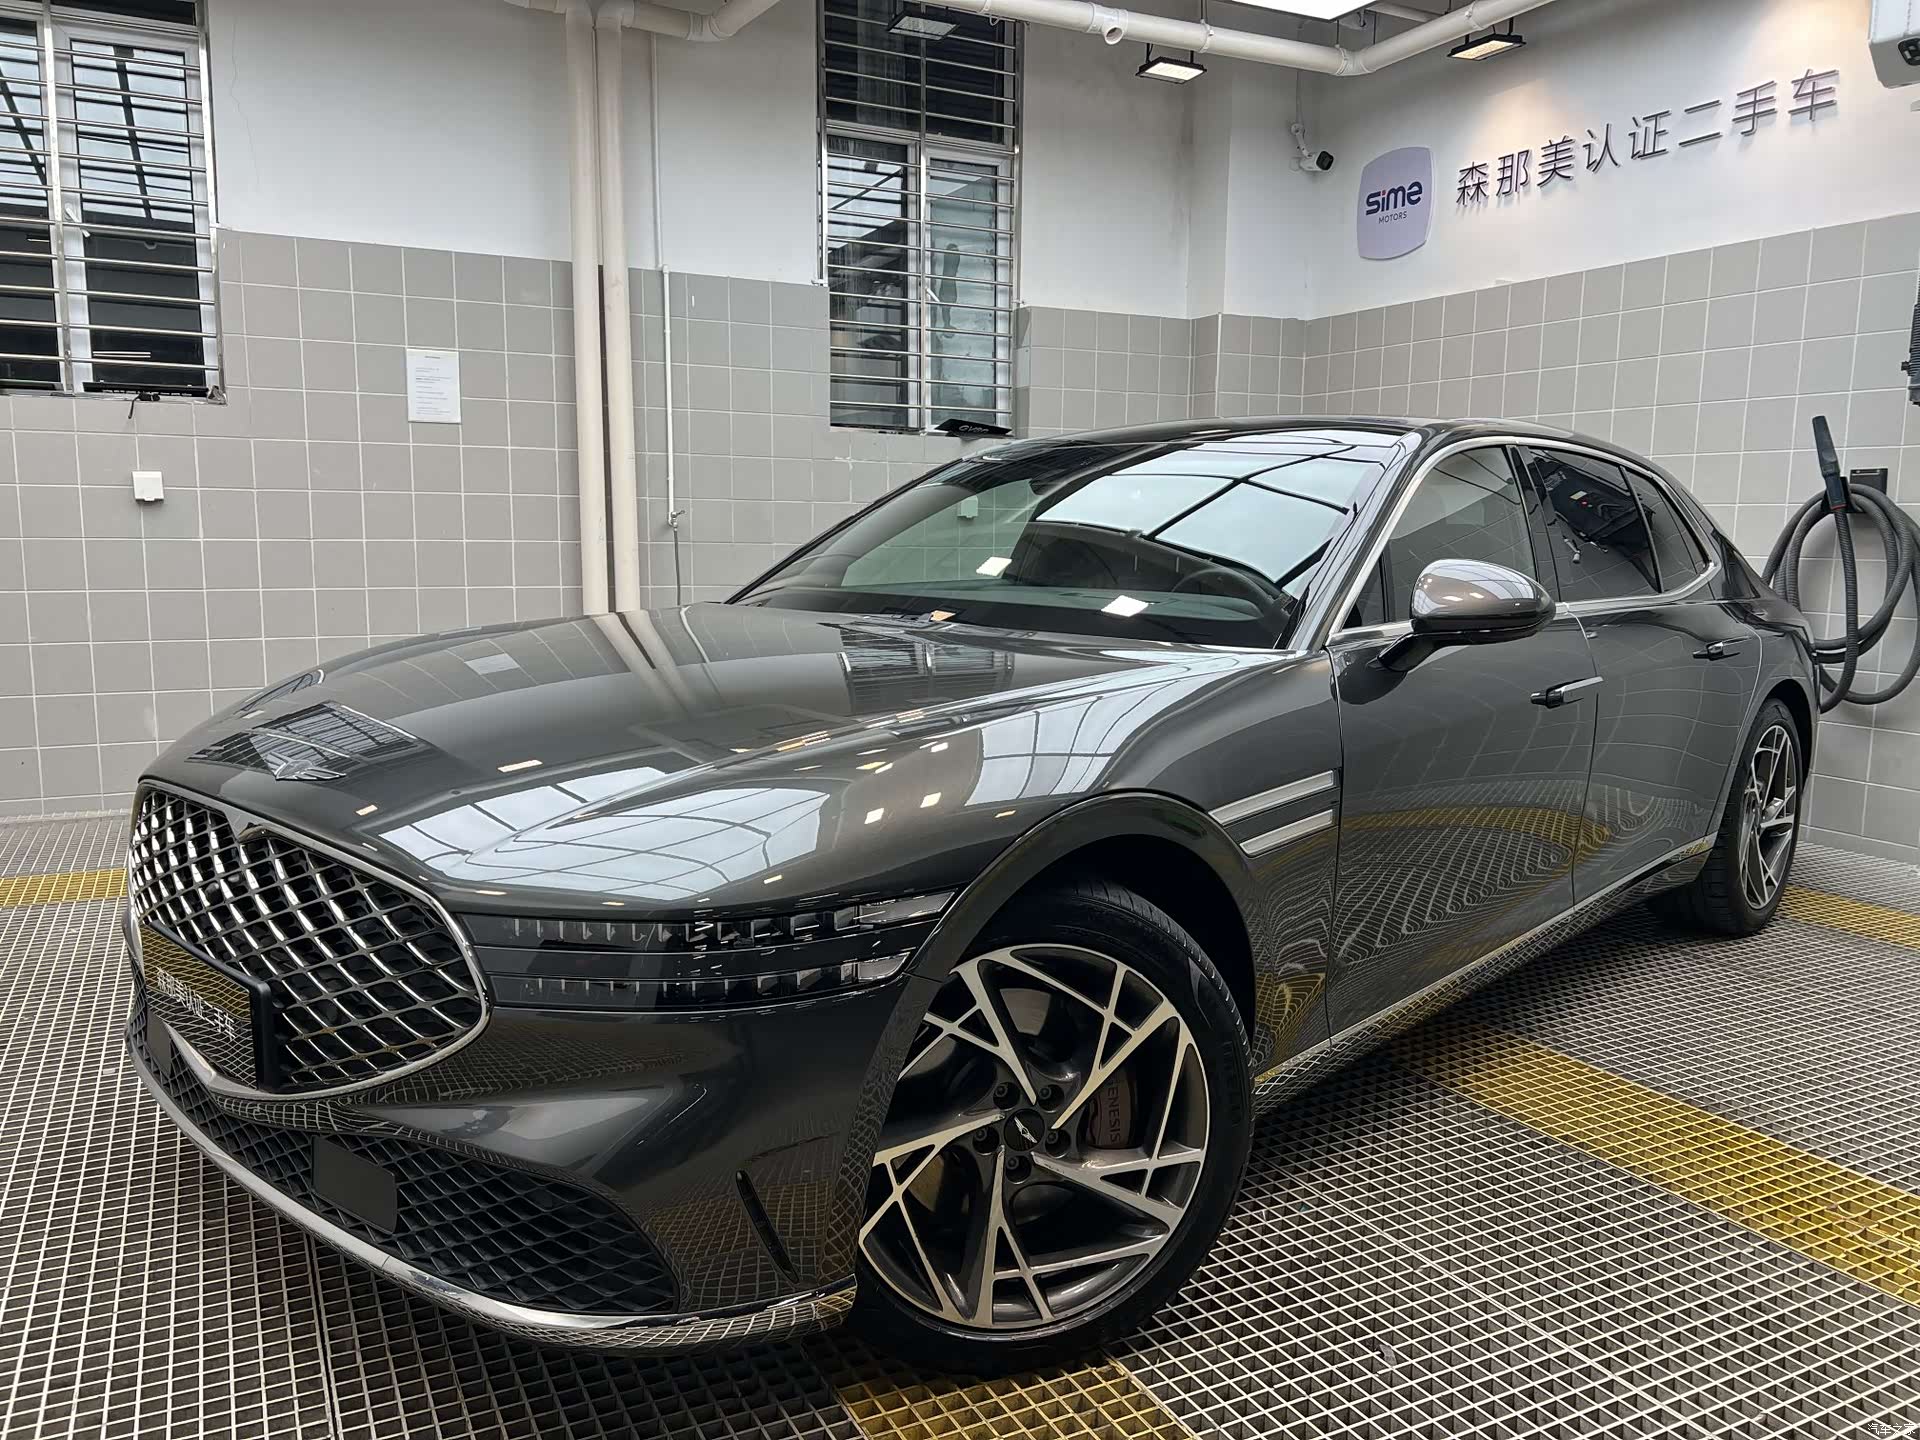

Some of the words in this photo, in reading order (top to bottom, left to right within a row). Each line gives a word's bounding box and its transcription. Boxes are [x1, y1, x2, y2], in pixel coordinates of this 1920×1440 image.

[1456, 68, 1840, 206] 森那美认证二手车
[1379, 211, 1408, 224] MOTORS
[1107, 1082, 1121, 1143] ENESIS
